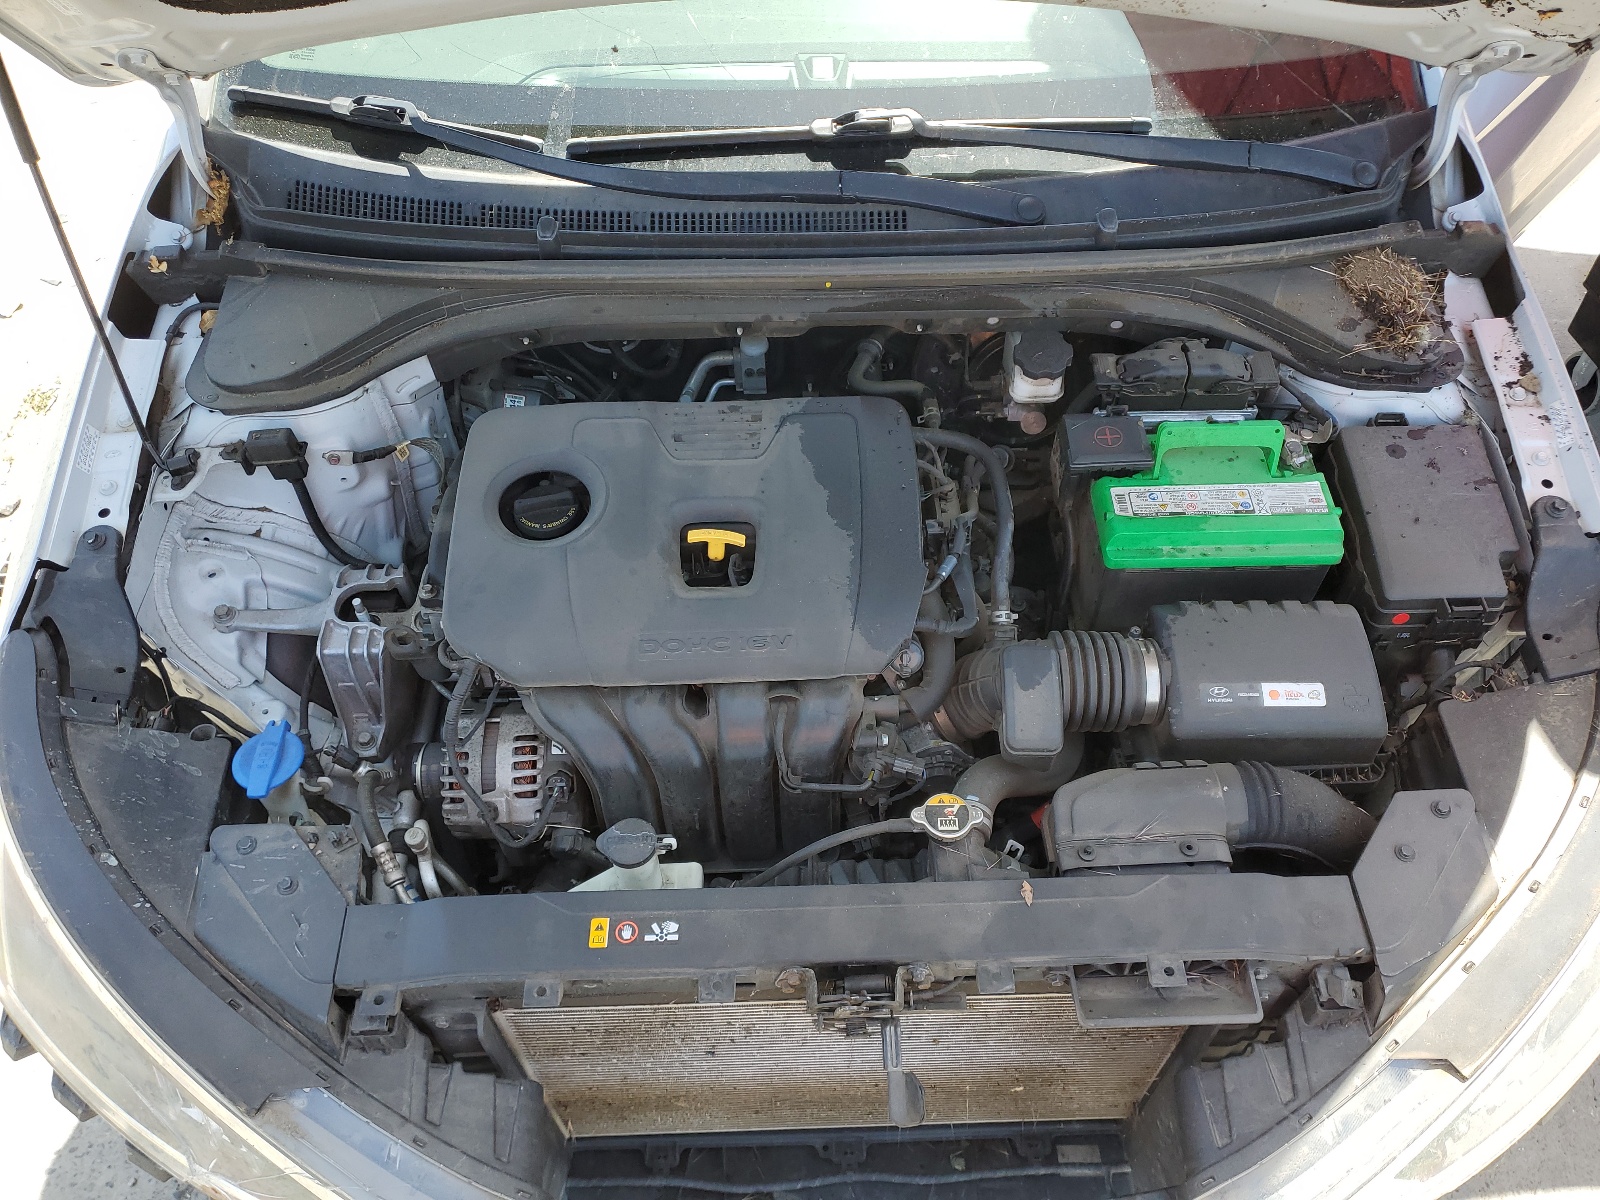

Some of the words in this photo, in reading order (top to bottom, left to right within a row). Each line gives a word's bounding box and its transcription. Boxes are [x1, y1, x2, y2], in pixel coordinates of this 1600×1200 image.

[519, 516, 541, 529] MANUAL
[638, 636, 731, 655] DOHC
[739, 634, 793, 651] 16V
